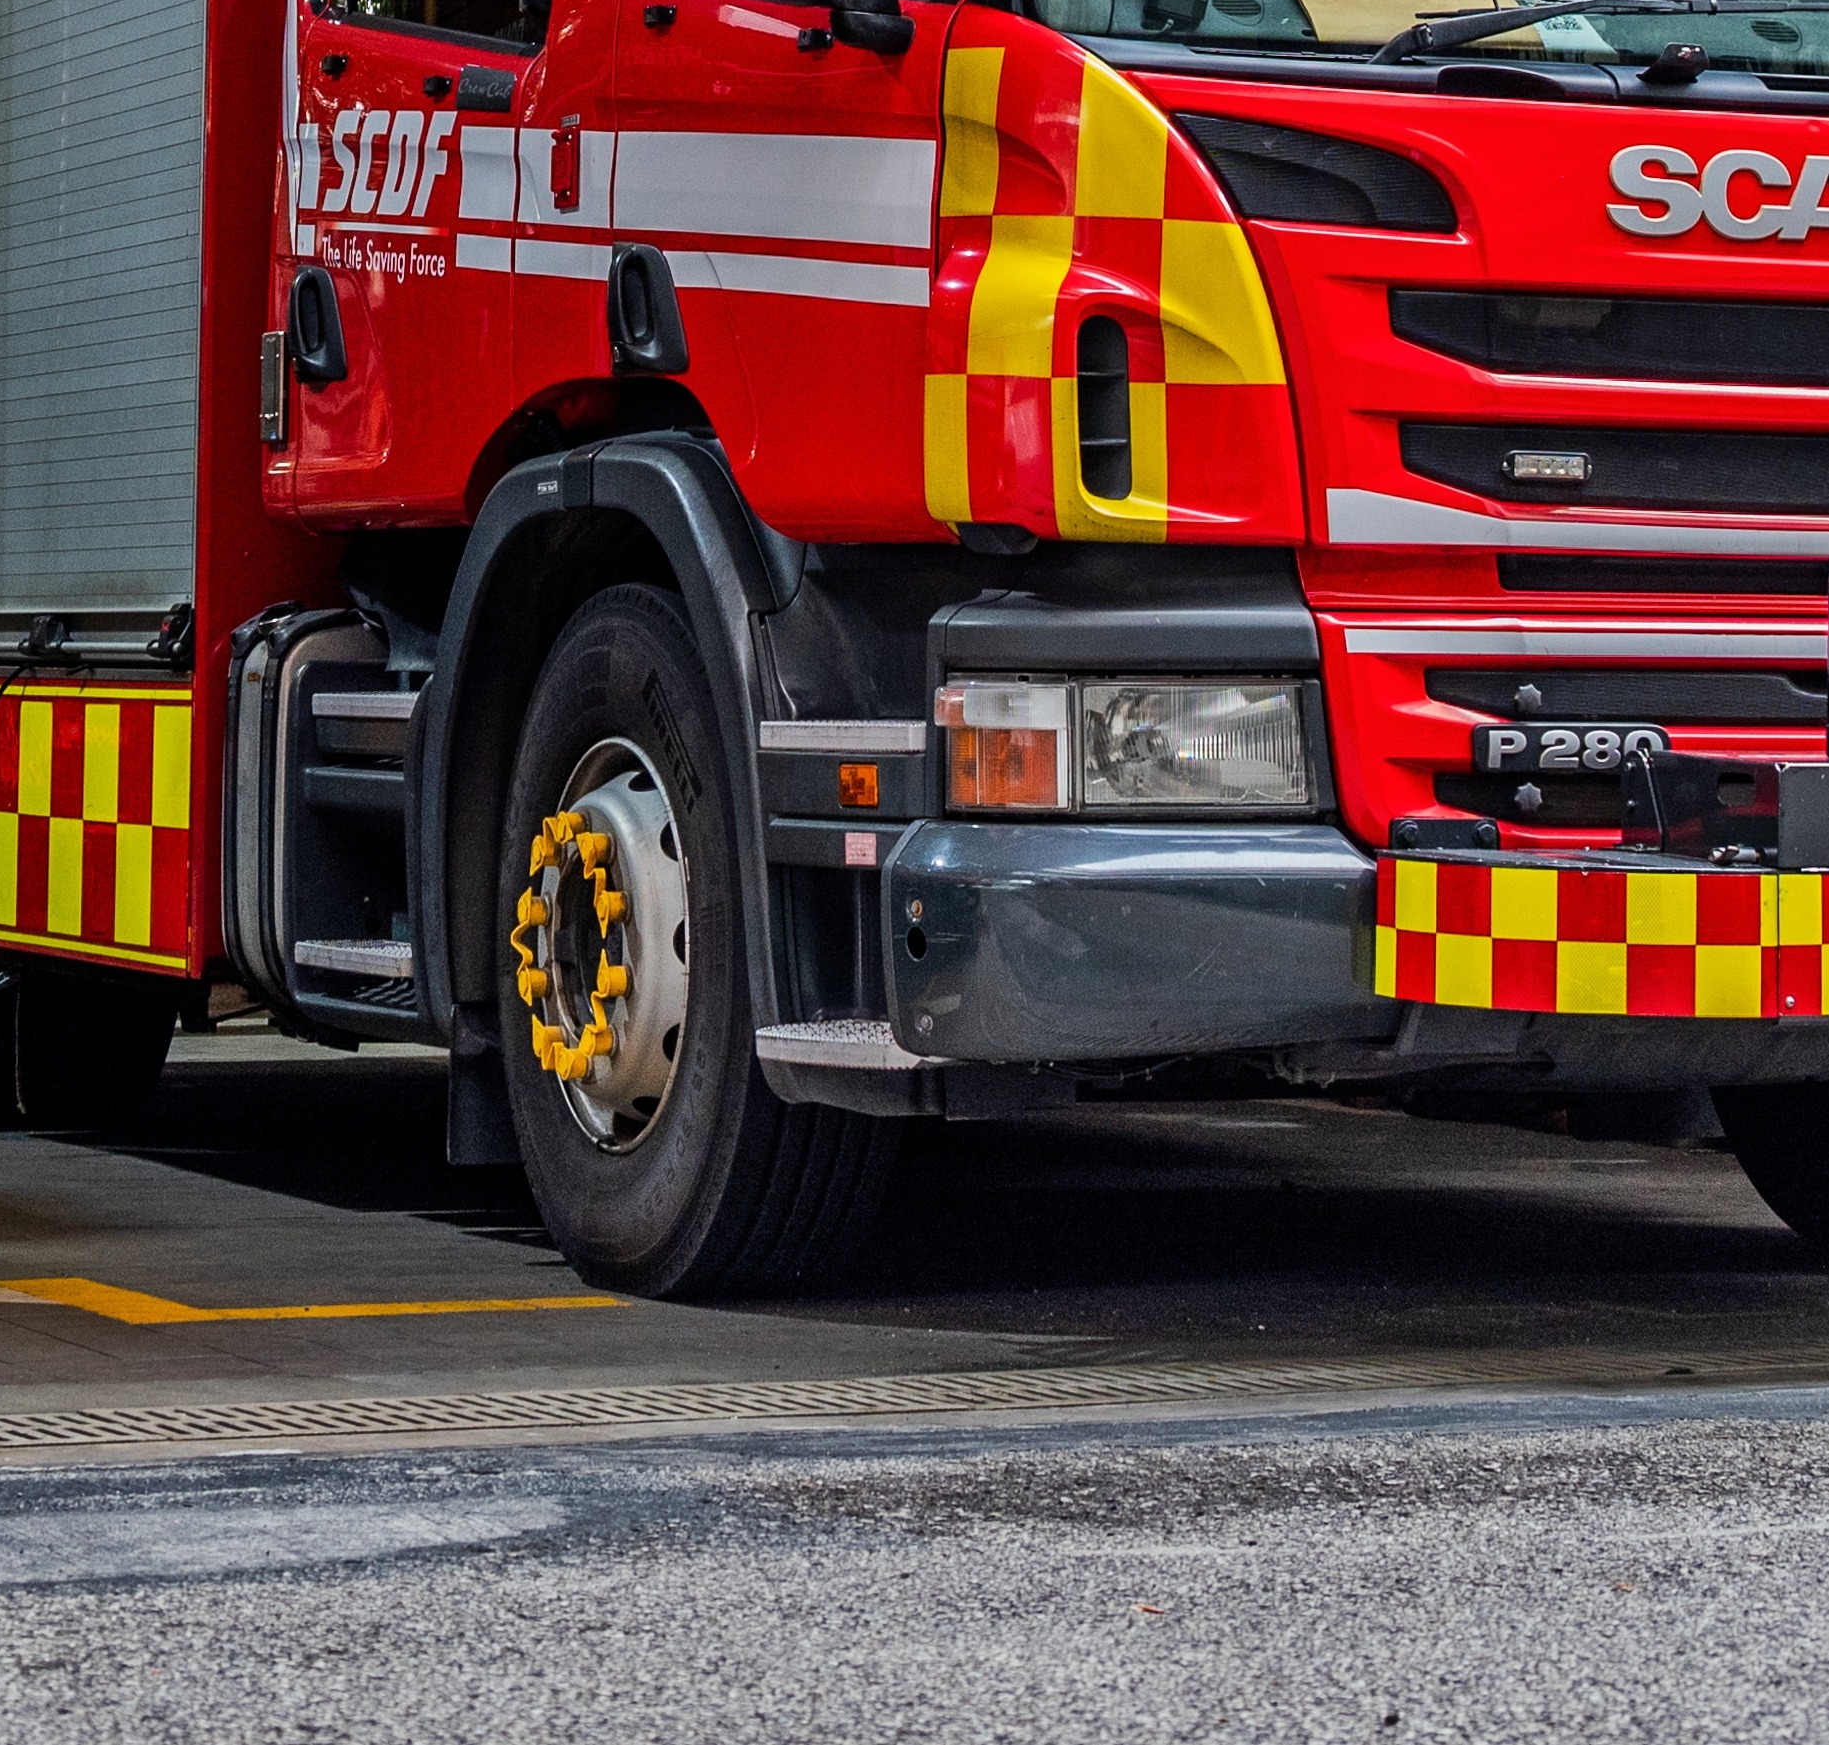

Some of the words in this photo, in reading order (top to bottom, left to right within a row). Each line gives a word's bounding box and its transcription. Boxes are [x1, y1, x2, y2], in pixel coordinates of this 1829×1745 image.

[322, 110, 458, 218] SCDF
[322, 237, 341, 268] The
[344, 240, 362, 270] Life
[366, 239, 406, 284] Saving
[410, 247, 446, 277] Force
[1488, 730, 1528, 768] P
